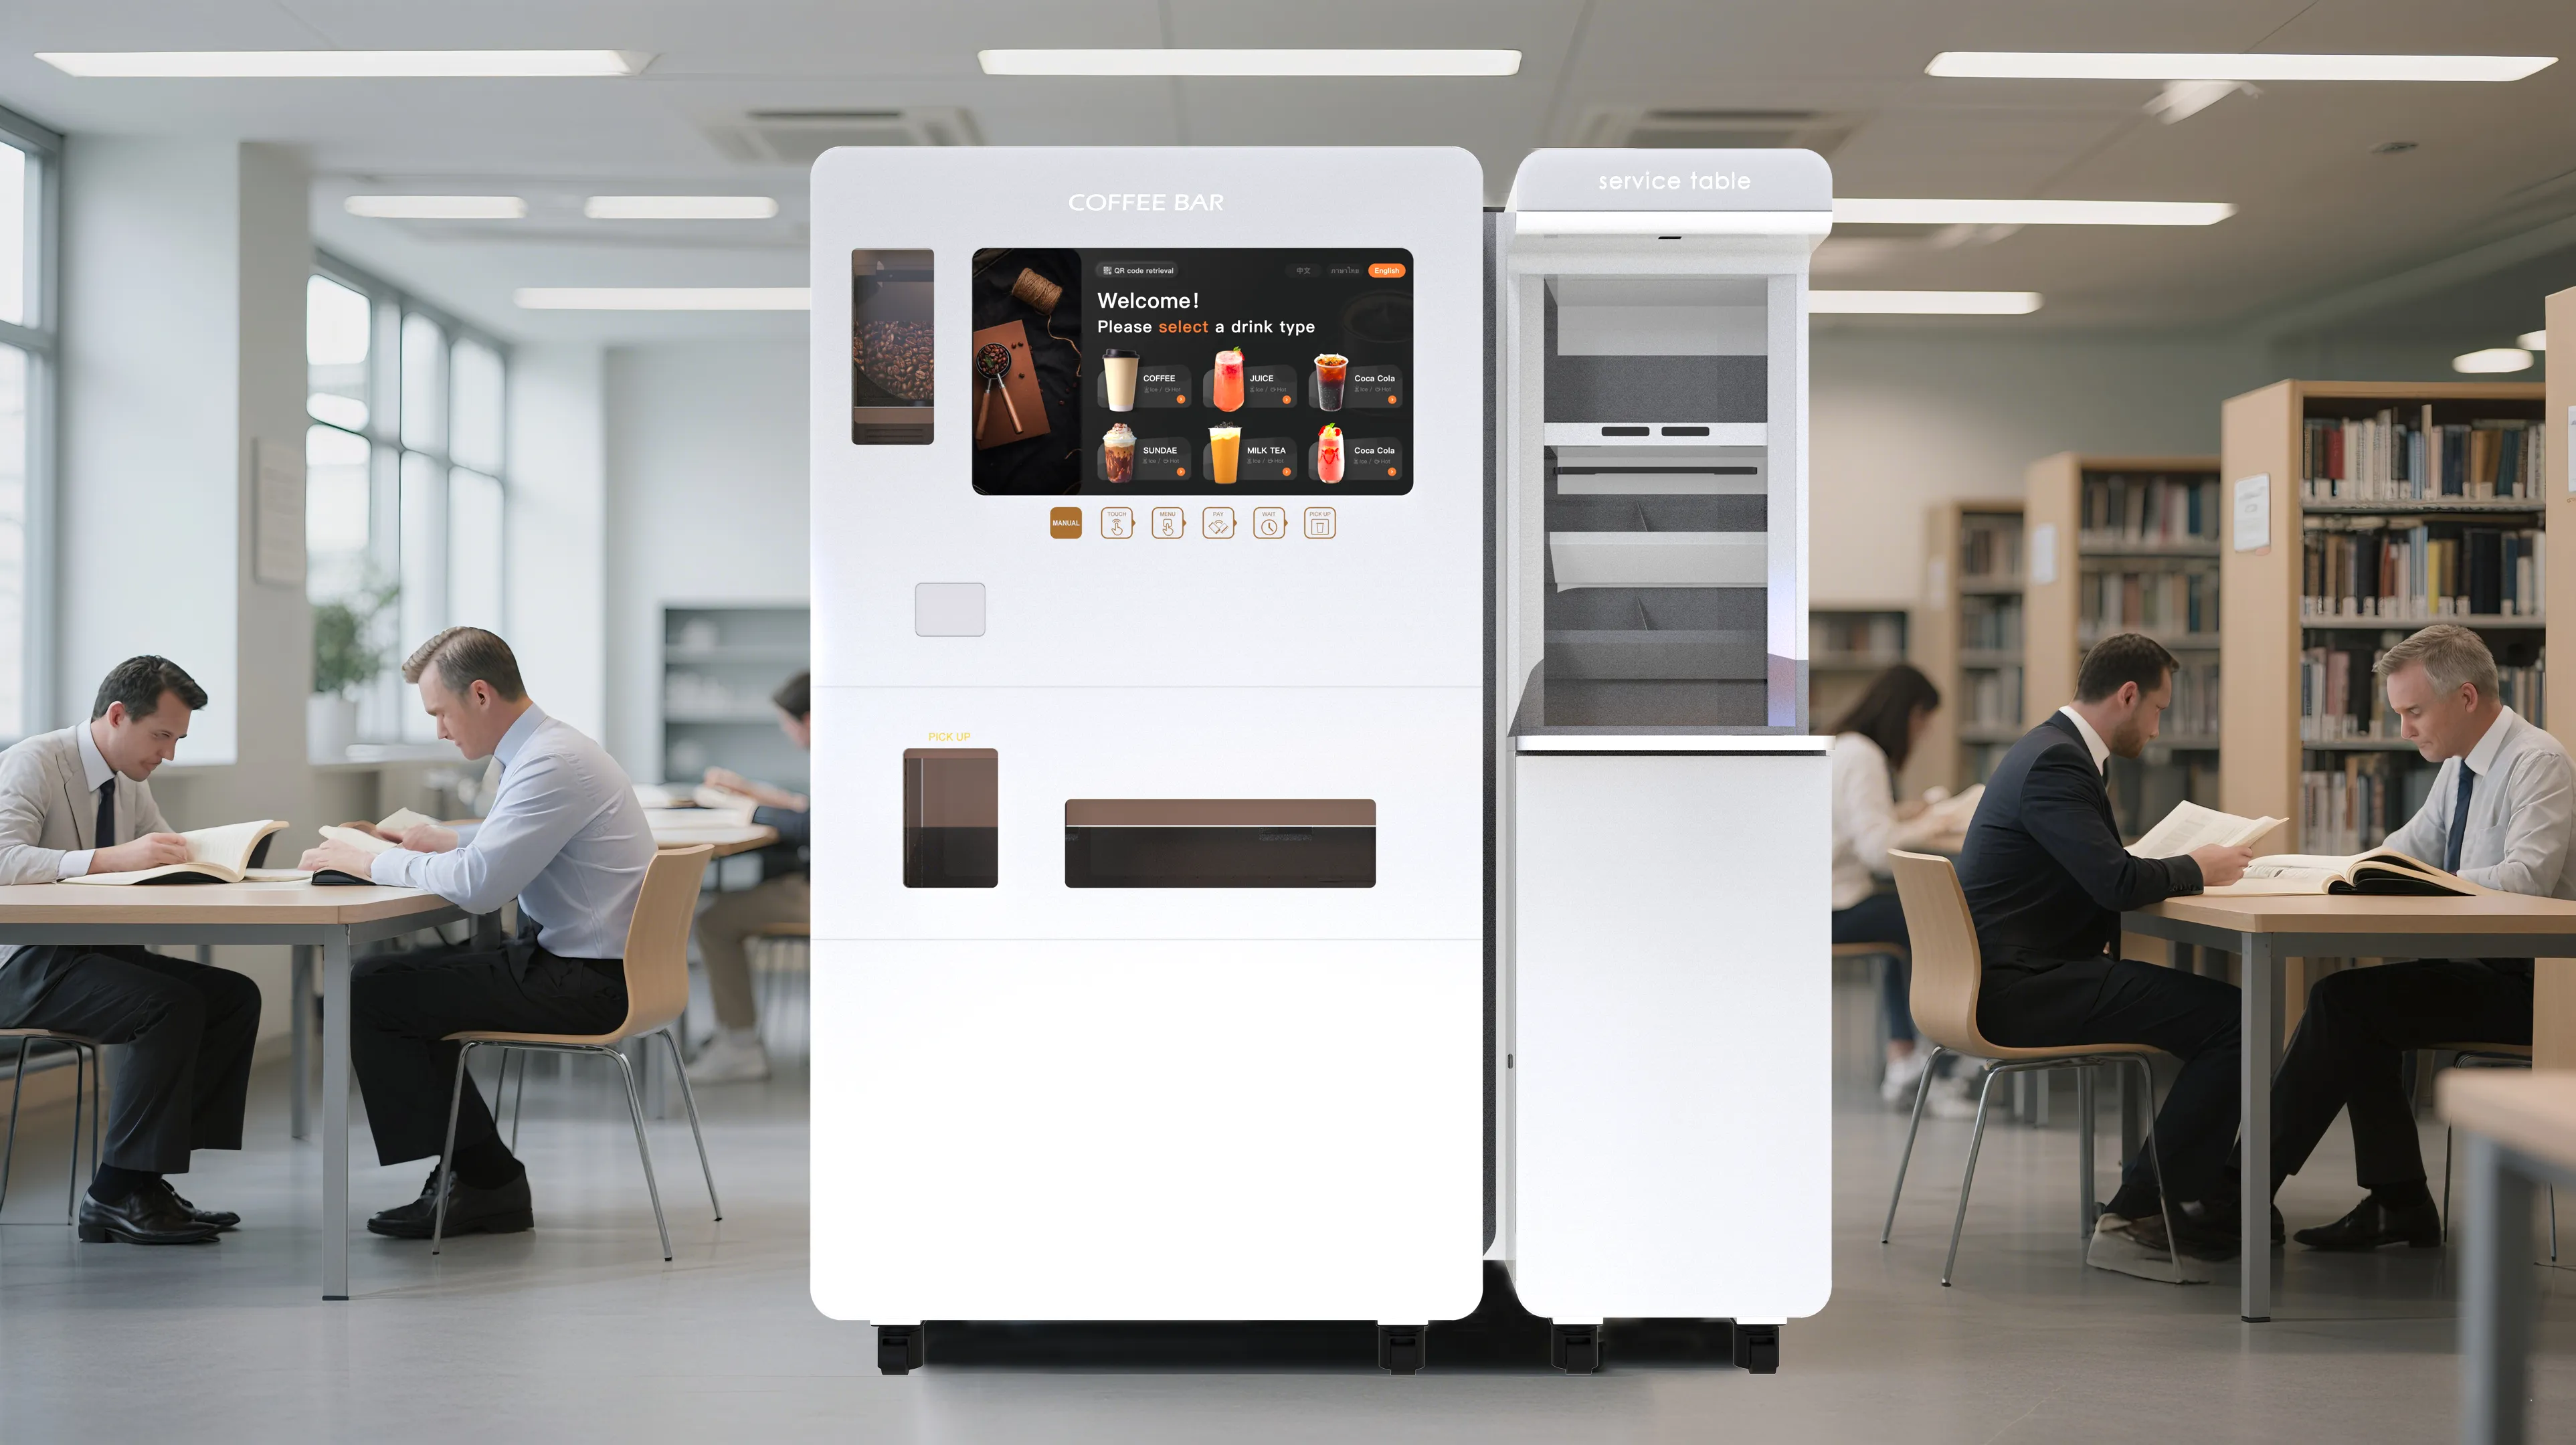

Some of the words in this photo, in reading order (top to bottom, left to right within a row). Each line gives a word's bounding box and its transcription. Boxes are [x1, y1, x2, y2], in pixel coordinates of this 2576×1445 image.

[1598, 170, 1681, 190] service
[1689, 171, 1751, 190] table
[1069, 193, 1166, 212] COFFEE
[1174, 193, 1224, 212] BAR
[1374, 267, 1400, 276] English
[1097, 292, 1198, 309] Welcome!
[1098, 320, 1152, 333] Please
[1158, 320, 1209, 333] select
[1215, 322, 1224, 333] a
[1231, 320, 1273, 333] drink
[1279, 320, 1315, 336] type
[928, 733, 954, 742] PICK
[956, 733, 971, 742] UP
